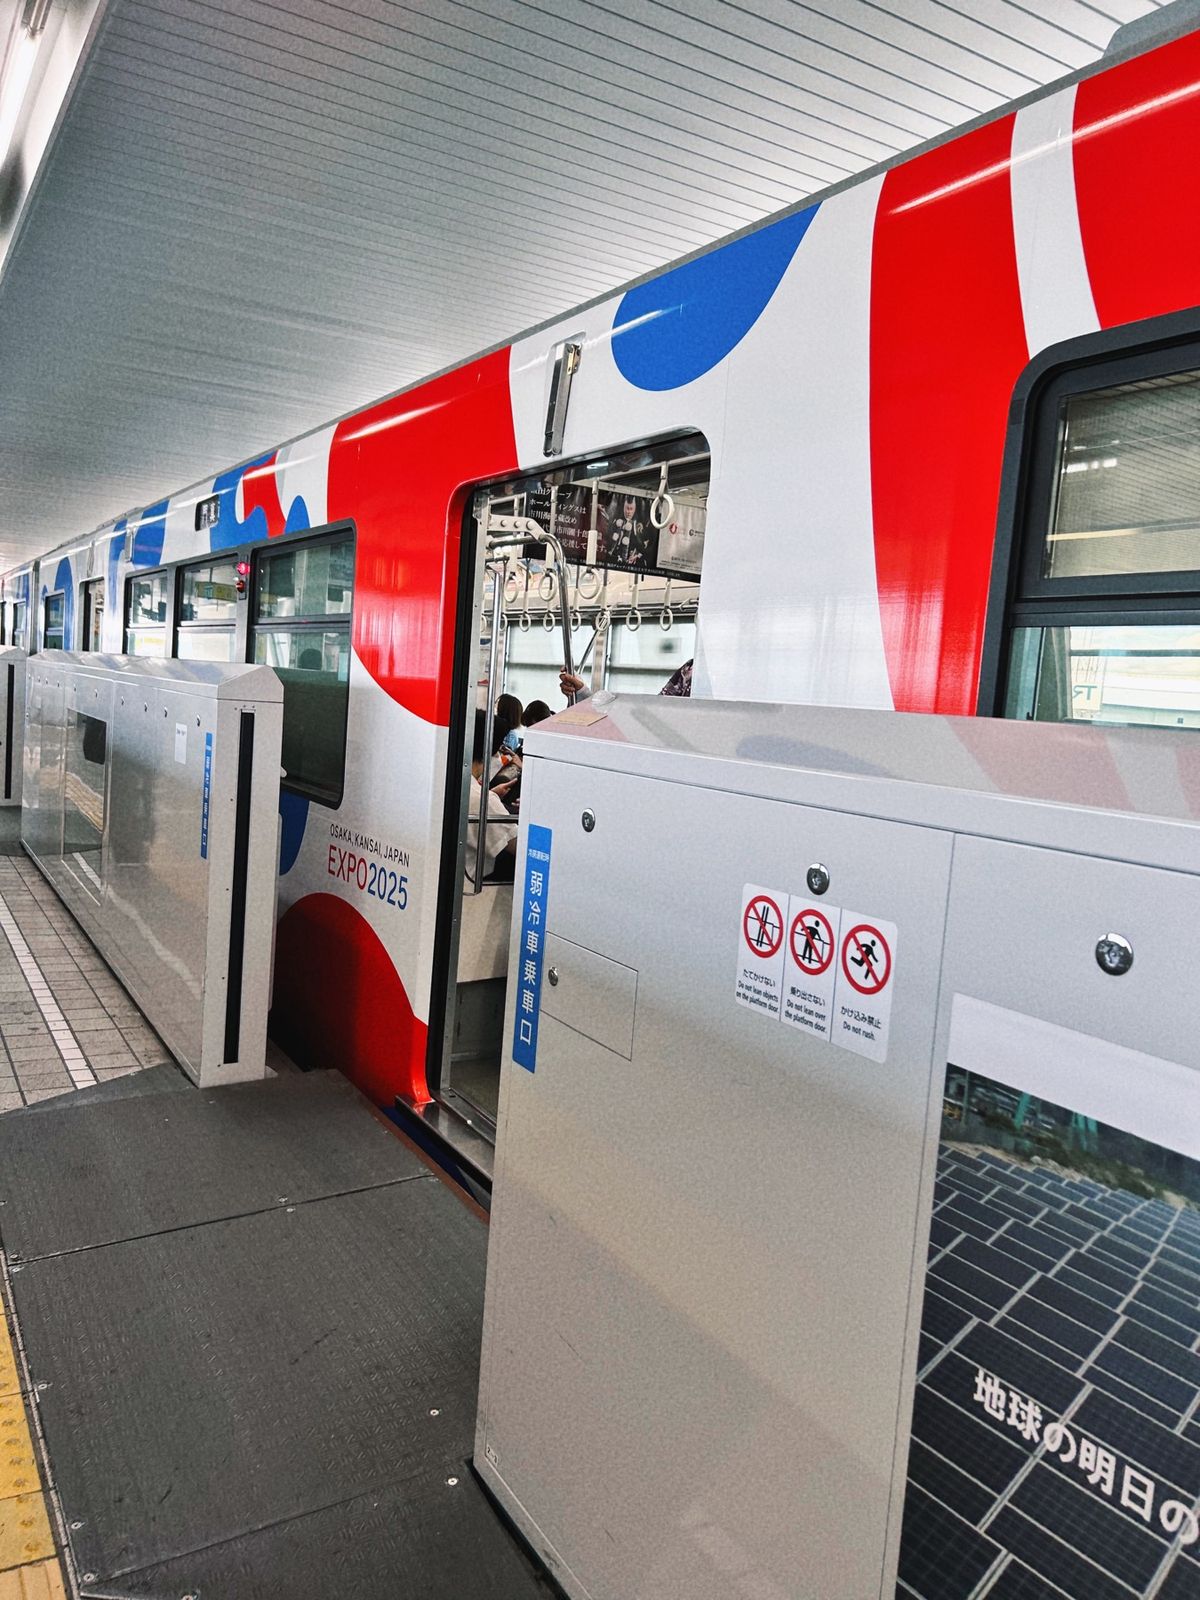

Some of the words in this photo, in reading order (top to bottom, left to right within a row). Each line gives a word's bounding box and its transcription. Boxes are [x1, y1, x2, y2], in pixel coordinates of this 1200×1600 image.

[330, 823, 354, 846] OSAKA,
[354, 833, 383, 858] KANSAI,
[383, 845, 410, 868] JAPAN
[328, 844, 408, 910] EXPO2025
[520, 870, 543, 1046] 弱冷車乗車口
[743, 968, 776, 987] たてかけない
[737, 980, 744, 989] Do
[744, 983, 752, 992] not
[753, 986, 762, 996] lean
[762, 989, 779, 1003] objects
[749, 996, 767, 1009] platform
[790, 986, 826, 1007] 乗り出さない
[786, 998, 794, 1008] Do
[794, 1003, 803, 1012] not
[803, 1005, 814, 1016] lean
[814, 1012, 826, 1022] over
[793, 1013, 813, 1028] platform
[840, 1006, 882, 1030] かけ込み禁止
[842, 1020, 851, 1031] Do
[851, 1025, 862, 1036] not
[862, 1030, 876, 1041] rush.
[973, 1368, 1199, 1545] 地球の明日の
